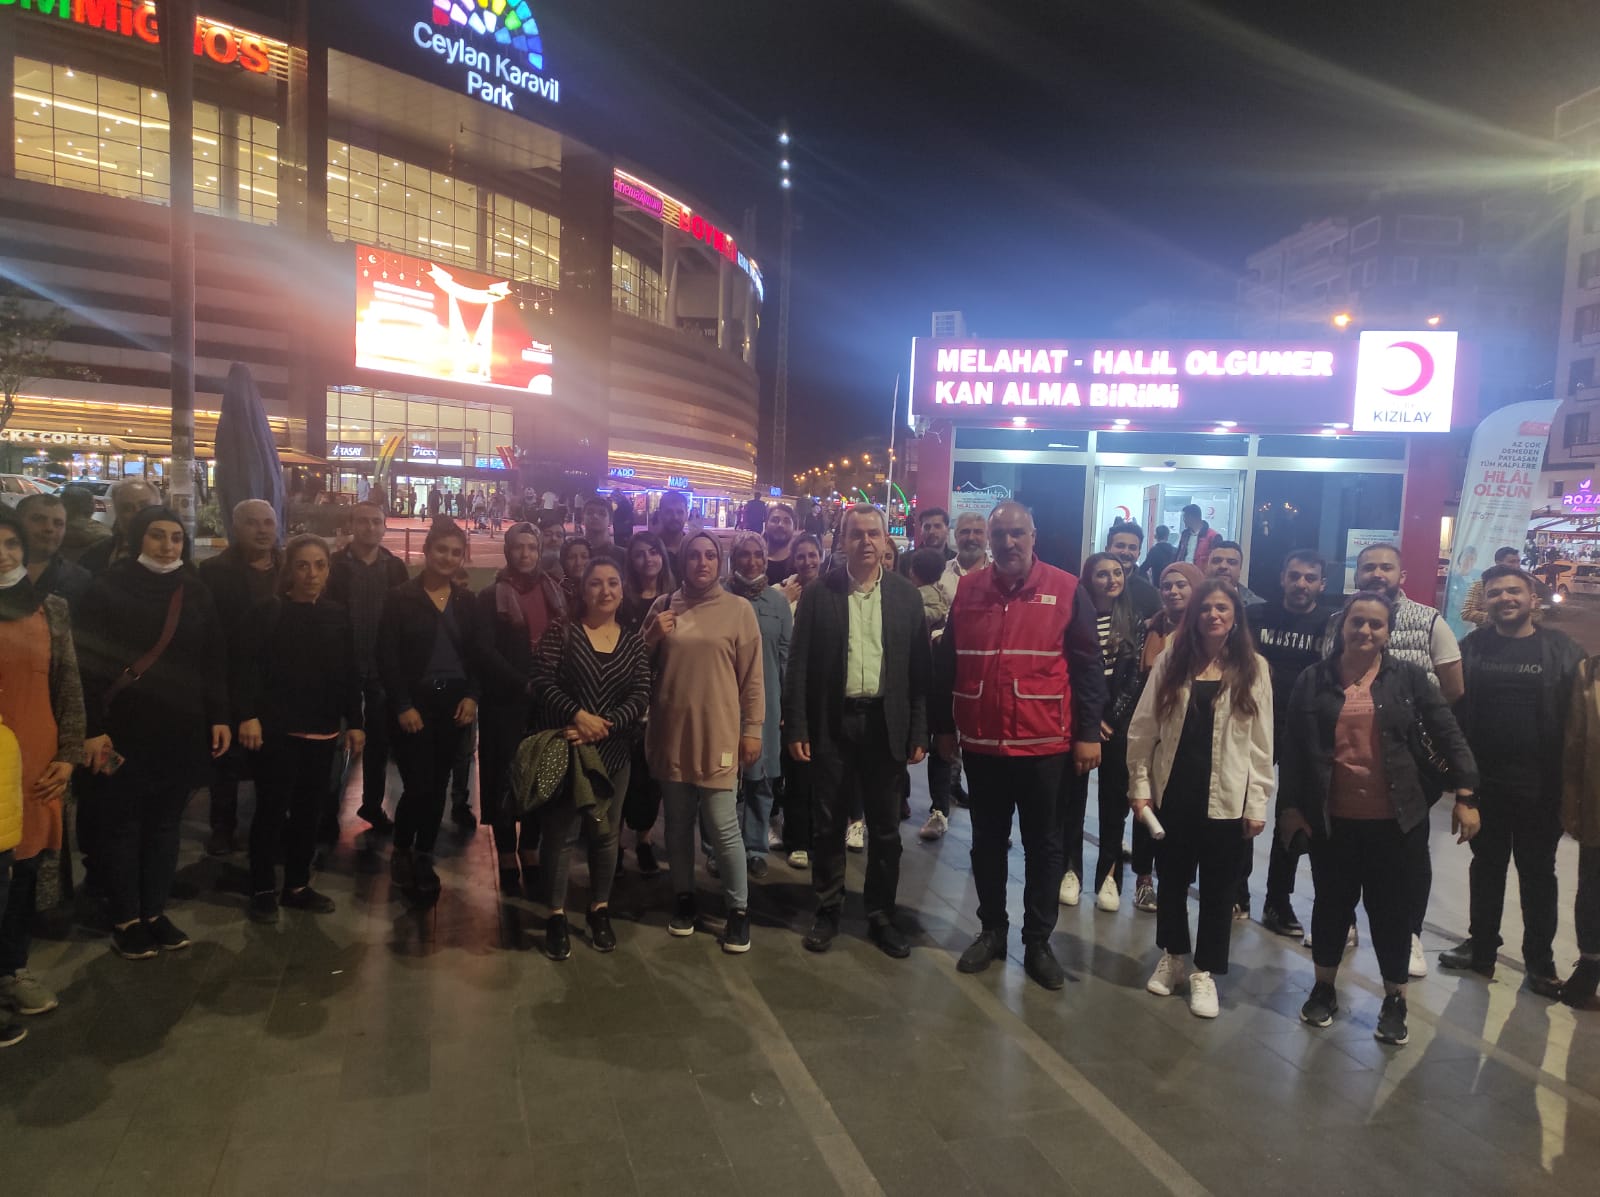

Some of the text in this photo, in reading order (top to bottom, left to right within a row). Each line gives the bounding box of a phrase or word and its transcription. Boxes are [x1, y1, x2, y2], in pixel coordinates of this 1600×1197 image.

[413, 21, 560, 103] Ceylan Karavil
[467, 70, 514, 110] Park
[937, 349, 1068, 374] MELAHAT
[935, 381, 993, 405] KAN
[1002, 382, 1081, 407] ALMA
[1373, 410, 1432, 423] KIZILAY
[40, 432, 110, 446] COFFEE
[1501, 448, 1539, 456] DEMEDEN
[1480, 459, 1537, 470] TÜM KALPLERE
[1473, 483, 1532, 498] OLSUN
